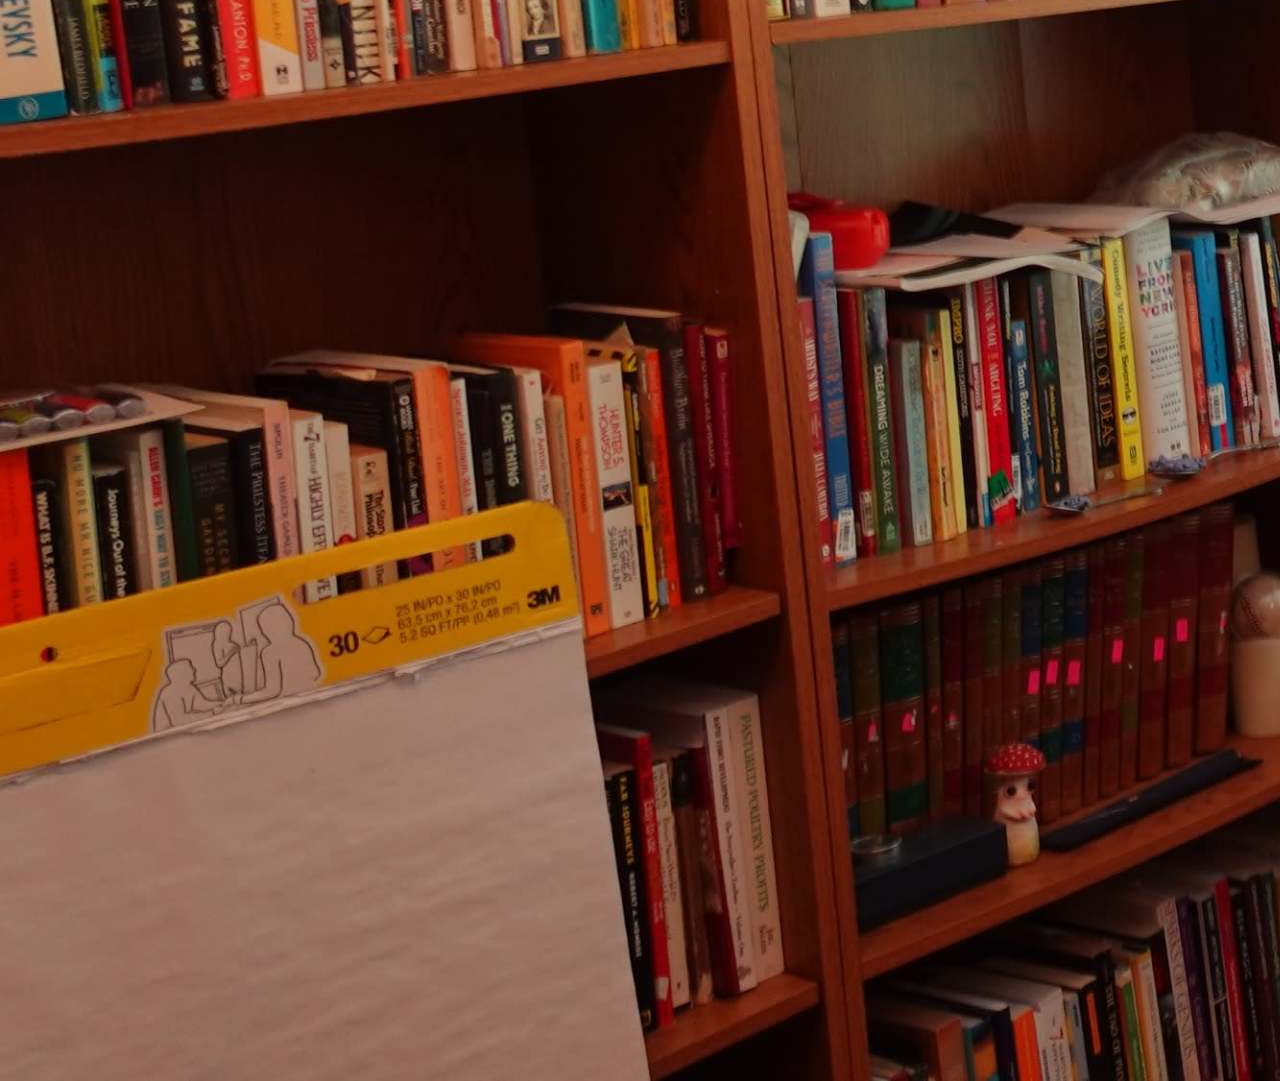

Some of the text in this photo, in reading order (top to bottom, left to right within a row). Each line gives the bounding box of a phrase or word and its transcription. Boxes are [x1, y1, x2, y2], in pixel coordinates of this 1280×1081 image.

[176, 0, 201, 68] FAME
[952, 299, 963, 343] IMPRO
[1096, 363, 1111, 389] OF
[1016, 361, 1031, 439] Tom Robbins
[1097, 393, 1115, 446] IDEAS
[500, 410, 520, 487] ONE THING
[872, 364, 888, 429] DREAMING
[881, 469, 893, 513] AWAKE
[35, 491, 49, 531] WHAT
[74, 478, 86, 515] MORE
[40, 532, 51, 544] IS
[104, 488, 127, 597] Journeys Out of the
[81, 547, 92, 578] NICE
[43, 567, 58, 611] SKINNE
[85, 583, 94, 603] GU
[527, 585, 561, 610] 3M
[328, 631, 359, 657] 30
